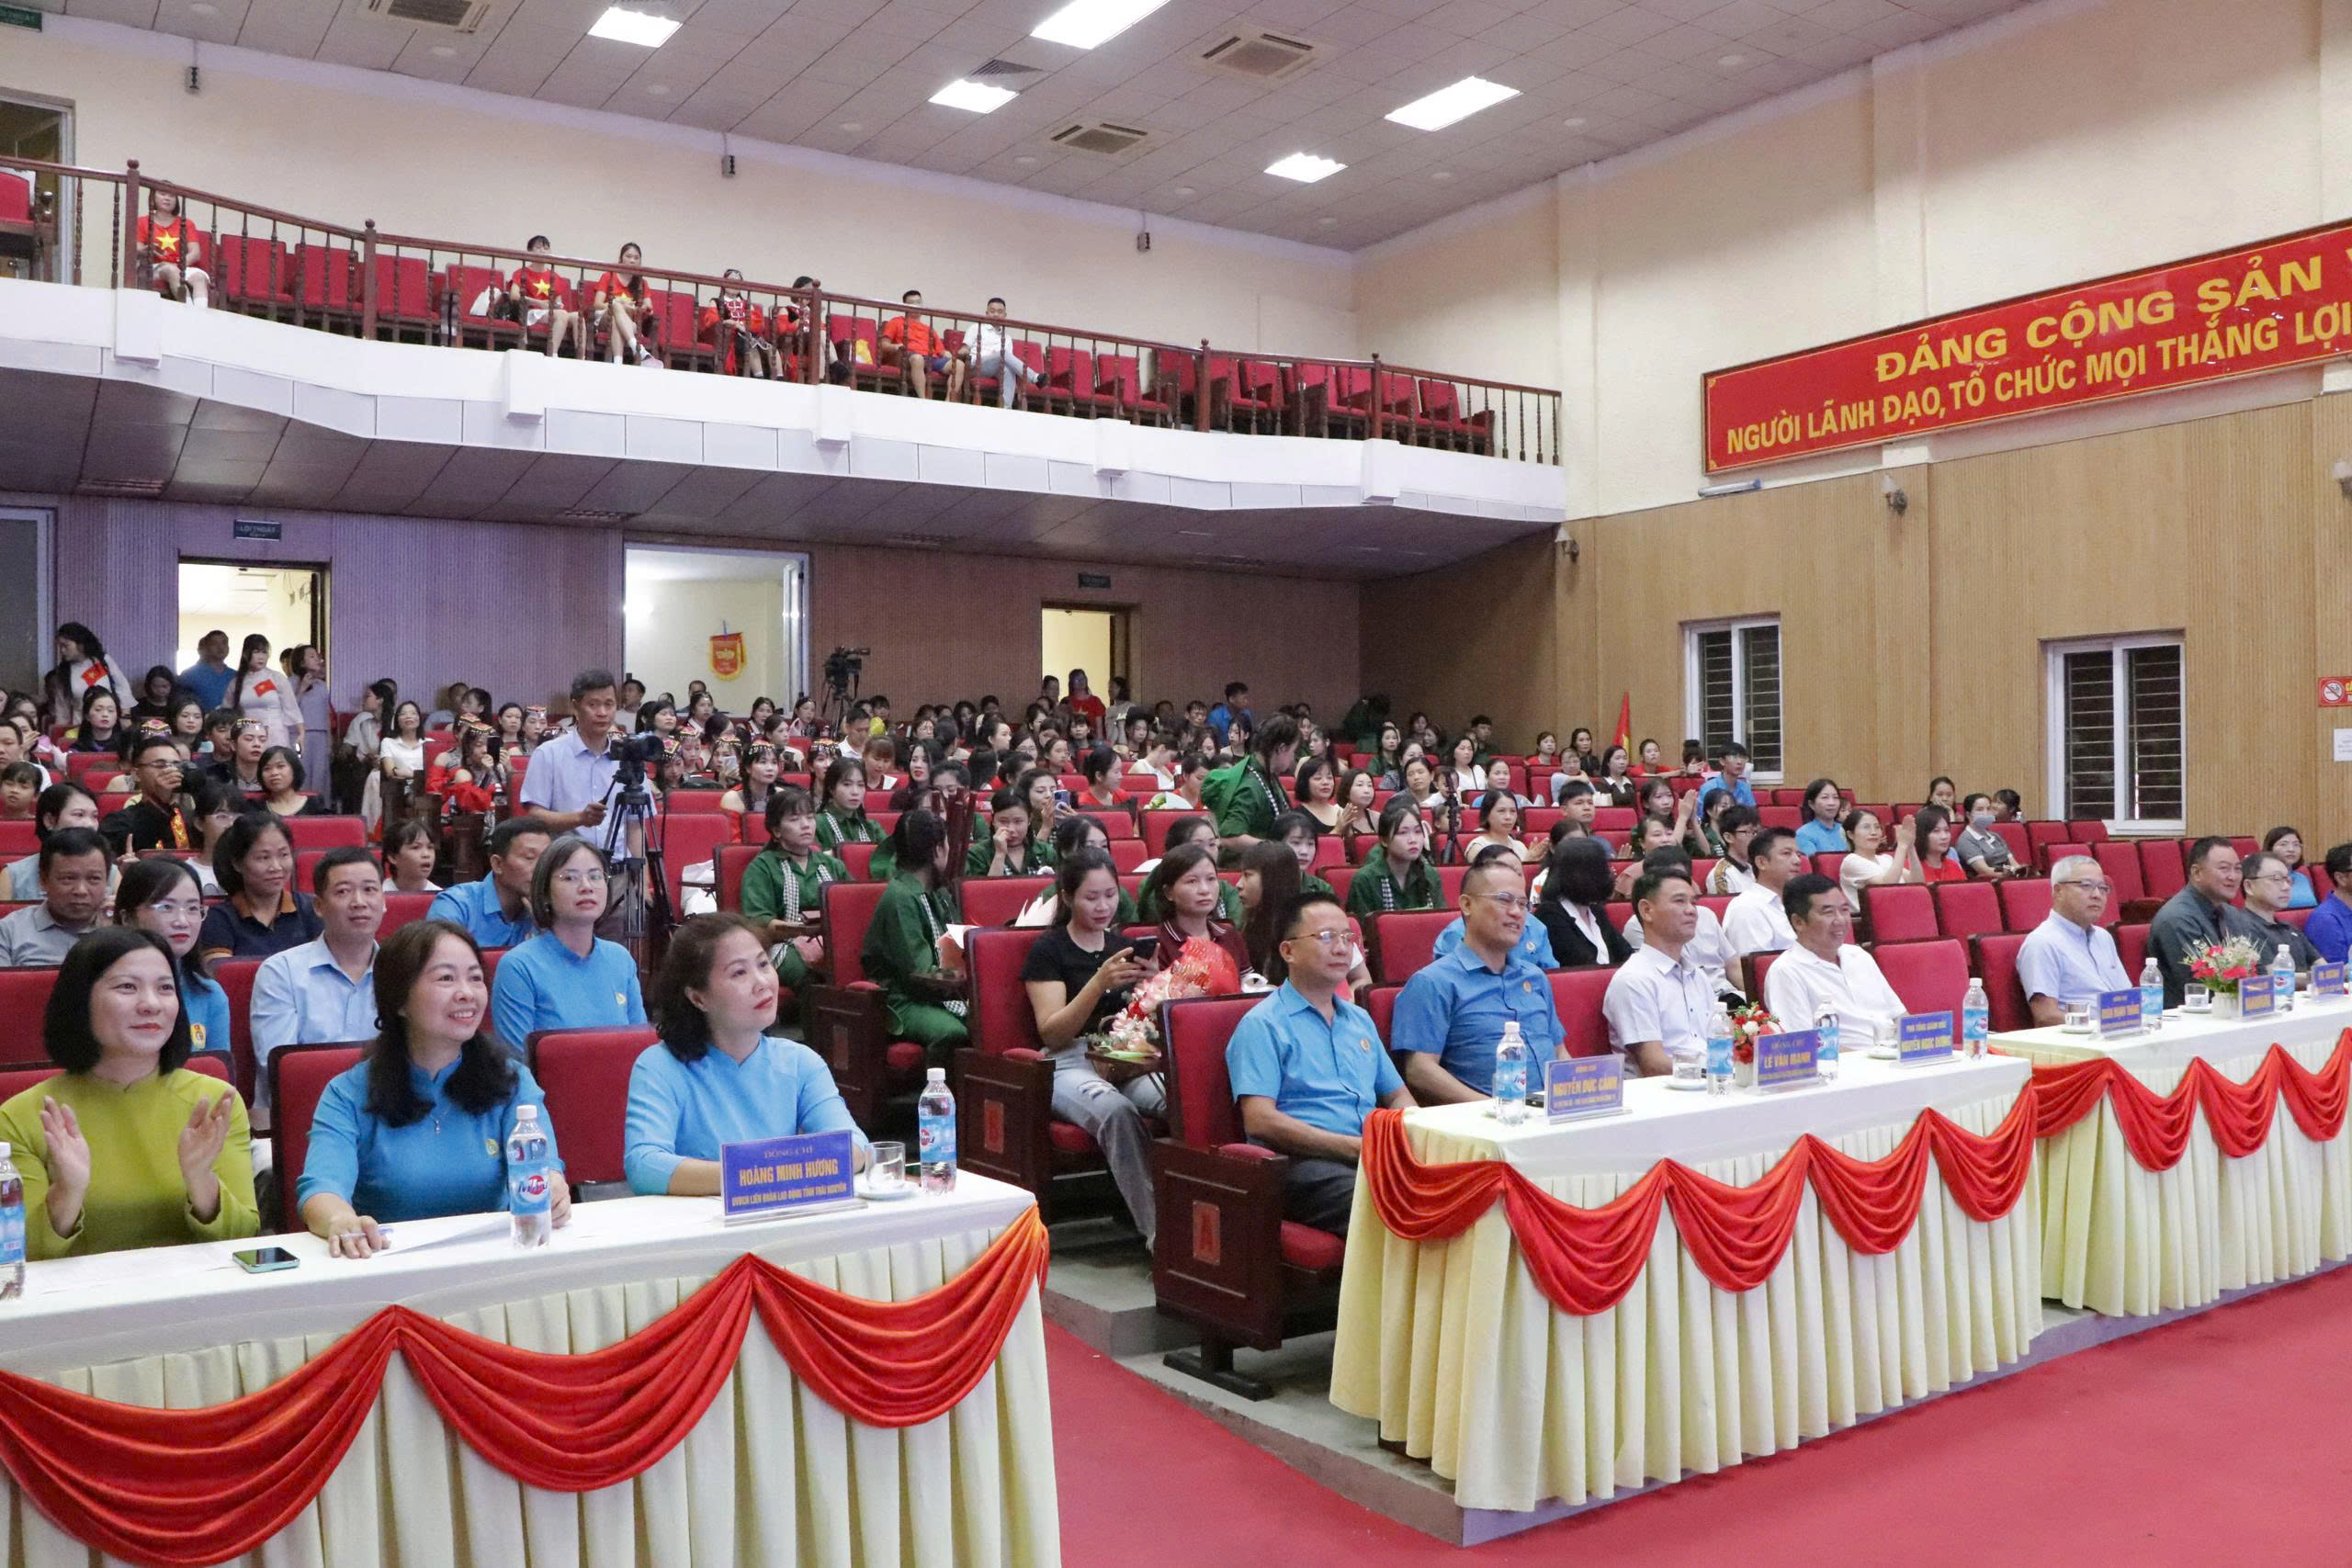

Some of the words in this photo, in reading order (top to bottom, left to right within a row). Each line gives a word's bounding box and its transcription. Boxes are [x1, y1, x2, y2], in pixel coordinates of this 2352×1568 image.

[1727, 410, 1801, 454] NGƯỜI
[1807, 399, 1874, 439] LÃNH
[1883, 387, 1946, 425] ĐẠO,
[1949, 363, 1985, 410] TỔ
[1995, 353, 2076, 402] CHỨC
[2086, 344, 2146, 387] MỌI
[2156, 312, 2278, 370] THẮNG
[2295, 301, 2351, 349] LỢI
[1875, 328, 2007, 382] ĐẢNG
[2026, 290, 2175, 348] CỘNG
[2197, 255, 2322, 313] SẢN
[740, 1166, 774, 1186] HOÀNG
[776, 1164, 803, 1181] MINH
